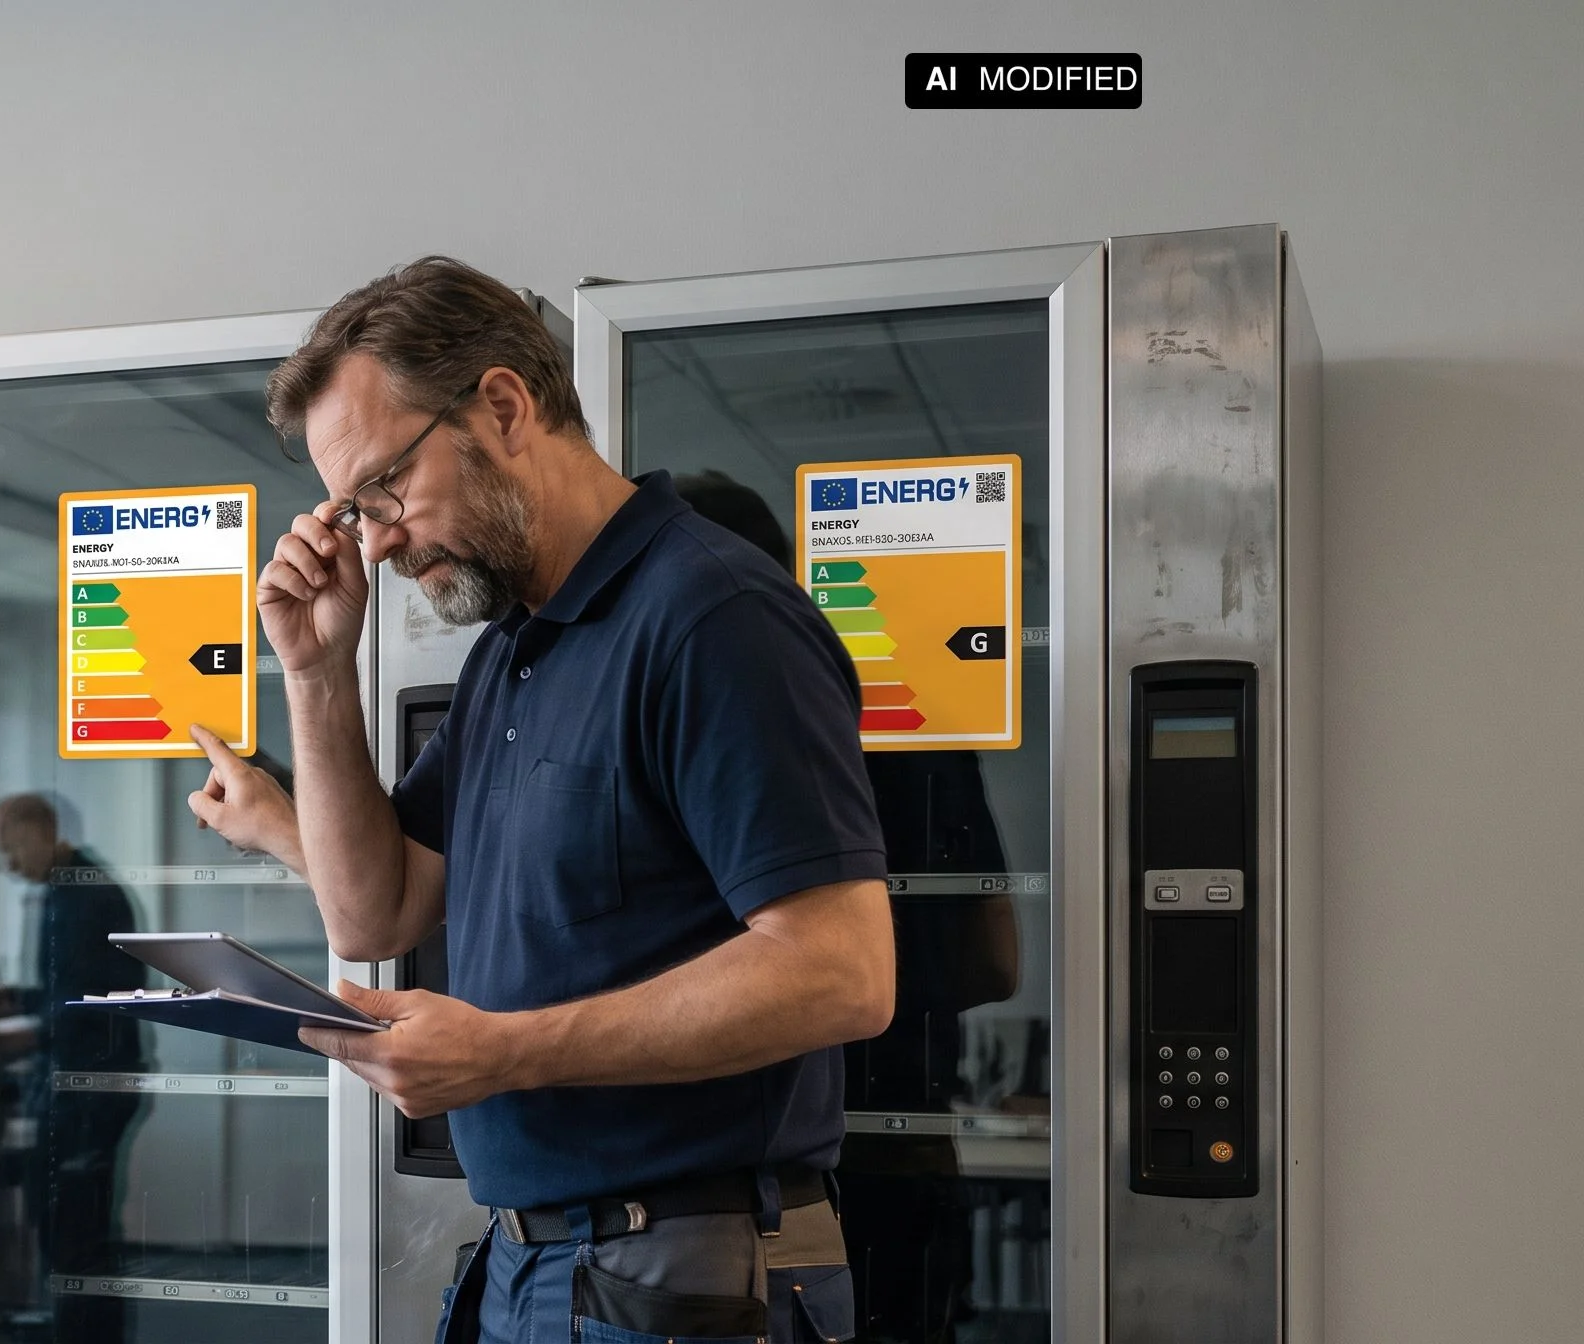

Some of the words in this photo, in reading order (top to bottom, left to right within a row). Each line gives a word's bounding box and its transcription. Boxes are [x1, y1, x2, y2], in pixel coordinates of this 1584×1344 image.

[811, 520, 859, 530] ENERGY
[72, 543, 114, 553] ENERGY
[816, 566, 830, 580] A
[77, 587, 88, 600] A
[818, 592, 829, 605] B
[77, 611, 87, 623] B
[76, 634, 87, 646] C
[969, 632, 989, 653] G
[77, 657, 88, 668] D
[213, 649, 226, 669] E
[77, 680, 86, 692] E
[77, 703, 86, 715] F
[77, 725, 88, 738] G
